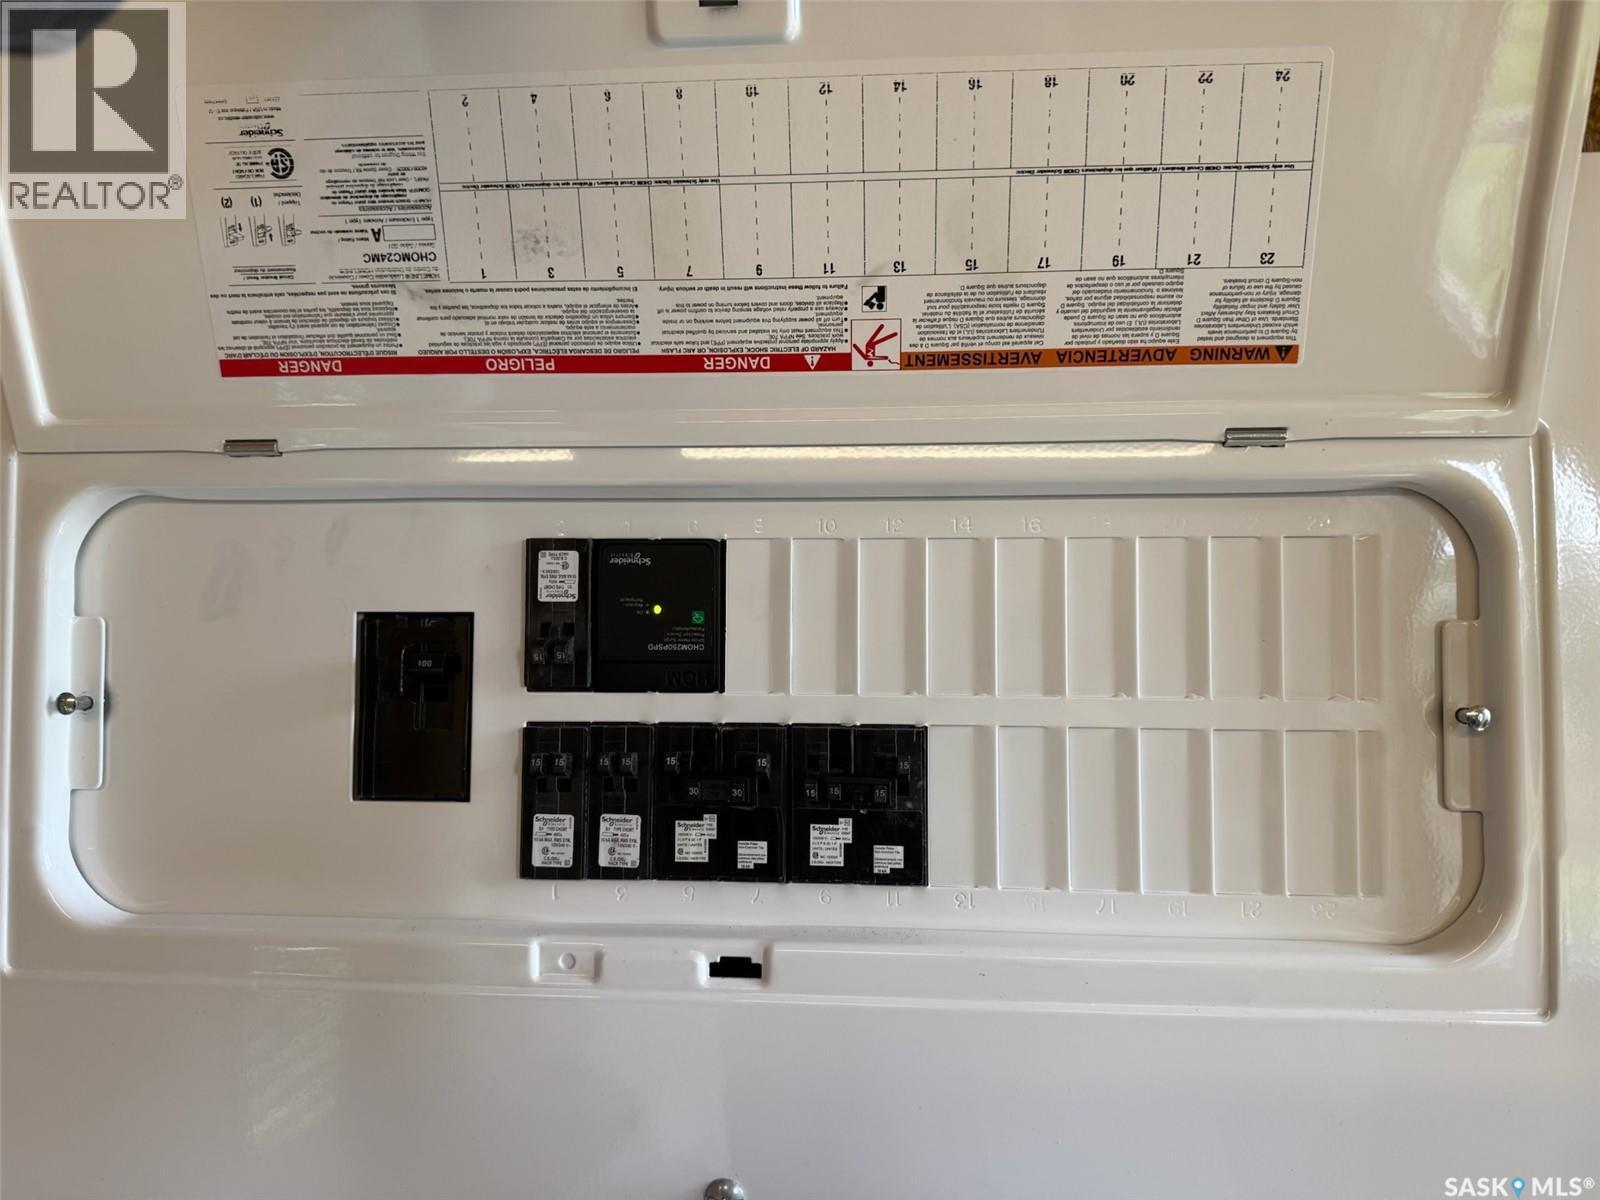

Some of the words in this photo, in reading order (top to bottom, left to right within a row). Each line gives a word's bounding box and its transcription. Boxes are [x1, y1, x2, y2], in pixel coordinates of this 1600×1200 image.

[1045, 76, 1058, 87] 18
[1121, 73, 1135, 86] 20
[1198, 72, 1213, 83] 22
[1275, 69, 1290, 82] 24
[819, 83, 833, 94] 12
[894, 80, 907, 92] 14
[968, 77, 982, 90] 16
[604, 89, 611, 101] 6
[676, 87, 682, 99] 8
[746, 85, 759, 97] 10
[462, 95, 468, 106] 2
[531, 92, 537, 104] 4
[221, 196, 232, 208] (2)
[251, 196, 262, 208] (1)
[371, 228, 381, 242] A
[362, 252, 437, 263] CHOMC24MC
[1037, 256, 1050, 269] 17
[1112, 255, 1125, 267] 19
[1187, 253, 1201, 265] 21
[1260, 253, 1275, 265] 23
[756, 264, 762, 275] 9
[823, 263, 835, 274] 11
[893, 260, 906, 272] 13
[966, 258, 978, 270] 15
[481, 268, 486, 279] 1
[548, 267, 554, 278] 3
[617, 266, 624, 278] 5
[686, 265, 693, 277] 7
[904, 352, 1042, 366] AVERTISSEMENT
[1056, 348, 1177, 363] ADVERTENCIA
[1190, 348, 1270, 360] WARNING
[278, 360, 342, 373] DANGER
[486, 358, 555, 371] PELIGRO
[702, 356, 771, 370] DANGER
[816, 518, 840, 536] 10
[882, 517, 905, 535] 12
[950, 516, 976, 533] 14
[609, 553, 651, 566] Schneider
[417, 659, 433, 667] 100
[532, 758, 540, 766] 15
[555, 758, 564, 766] 15
[666, 757, 676, 765] 15
[757, 758, 767, 767] 15
[689, 787, 699, 795] 30
[732, 788, 742, 797] 30
[806, 789, 816, 797] 15
[876, 789, 885, 797] 15
